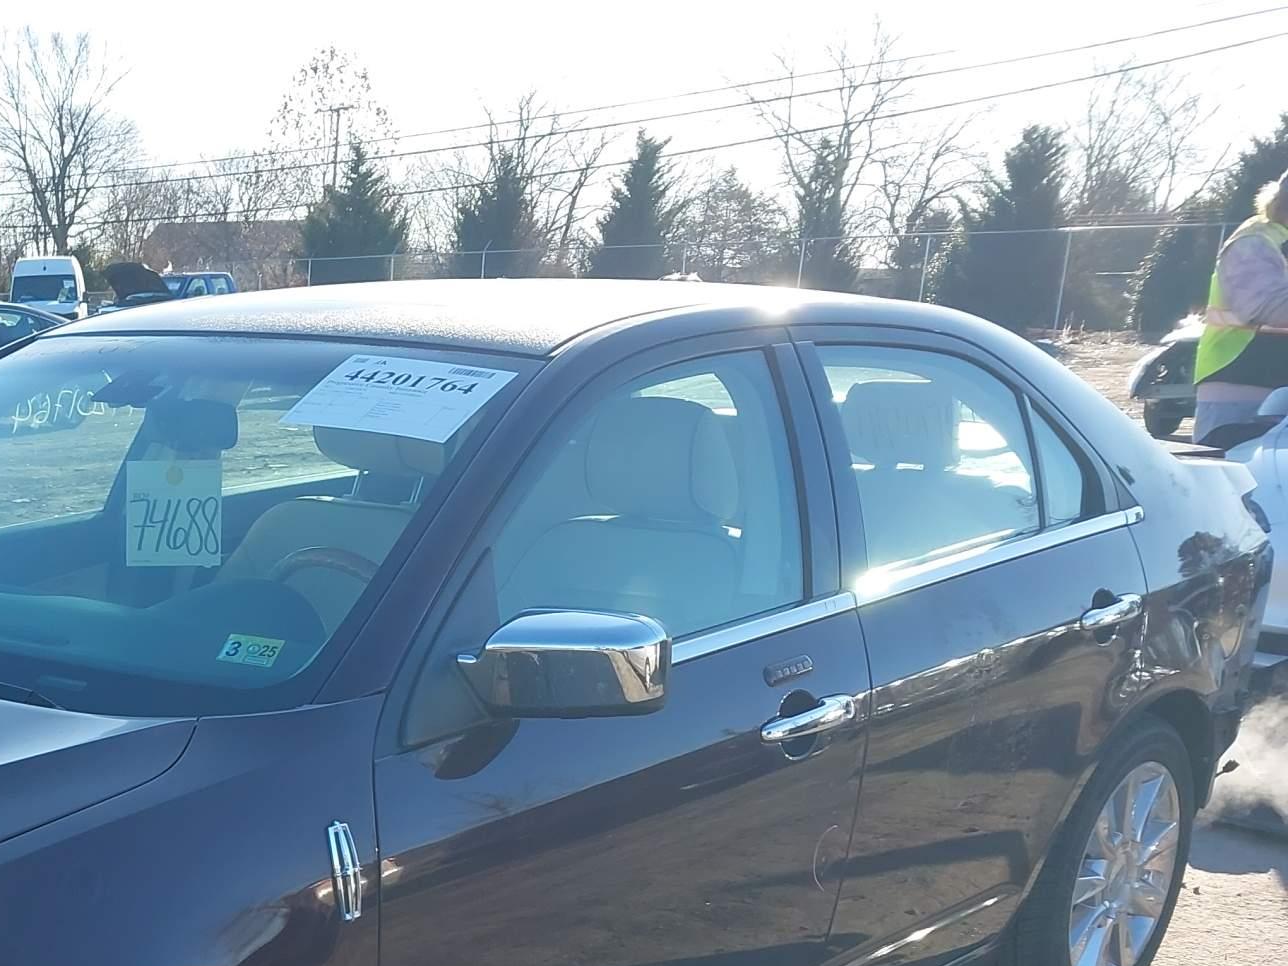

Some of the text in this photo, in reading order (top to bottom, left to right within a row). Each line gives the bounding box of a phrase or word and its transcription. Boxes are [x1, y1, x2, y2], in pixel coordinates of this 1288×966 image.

[344, 367, 479, 395] 44201764
[129, 496, 220, 556] 74688
[225, 640, 279, 658] 3 25
